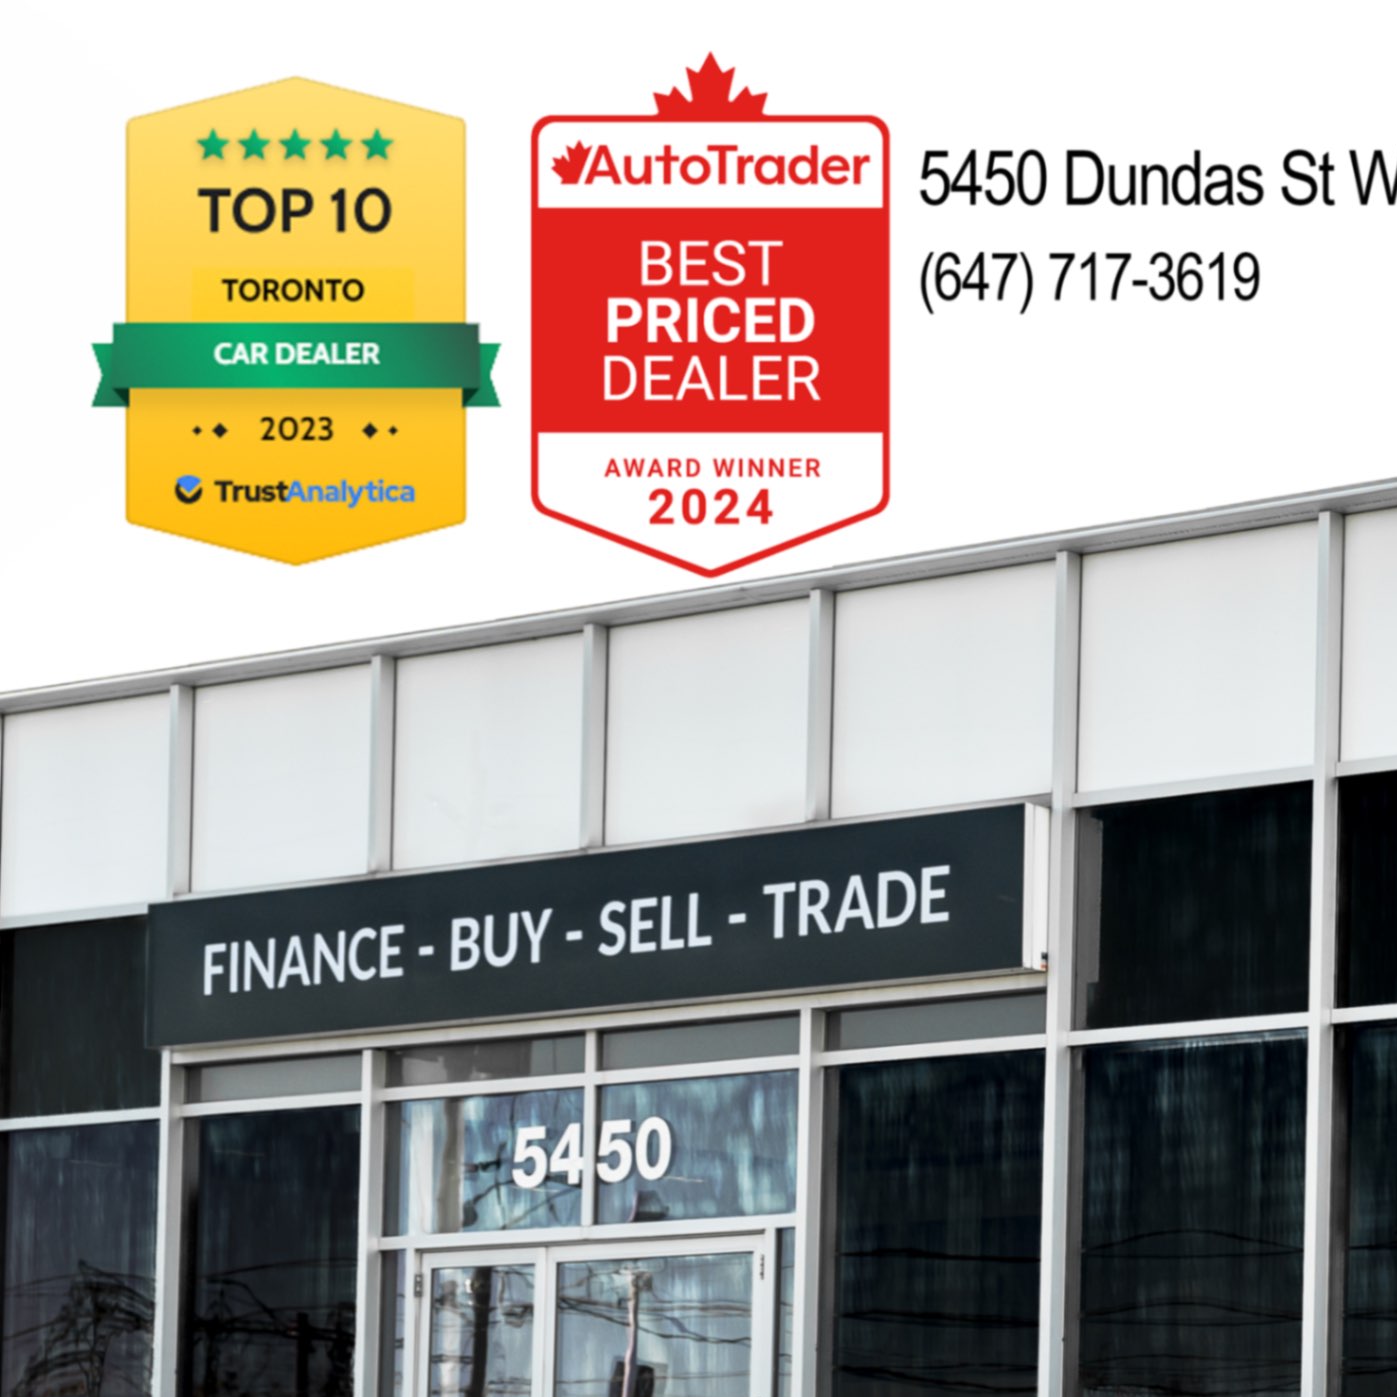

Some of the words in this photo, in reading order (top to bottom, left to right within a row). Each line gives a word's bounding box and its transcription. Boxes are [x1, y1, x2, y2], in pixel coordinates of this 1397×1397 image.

[203, 924, 405, 996] FINANCE
[450, 908, 553, 971] BUY
[598, 892, 712, 956] SELL
[763, 865, 950, 939] TRADE
[511, 1116, 672, 1189] 5450
